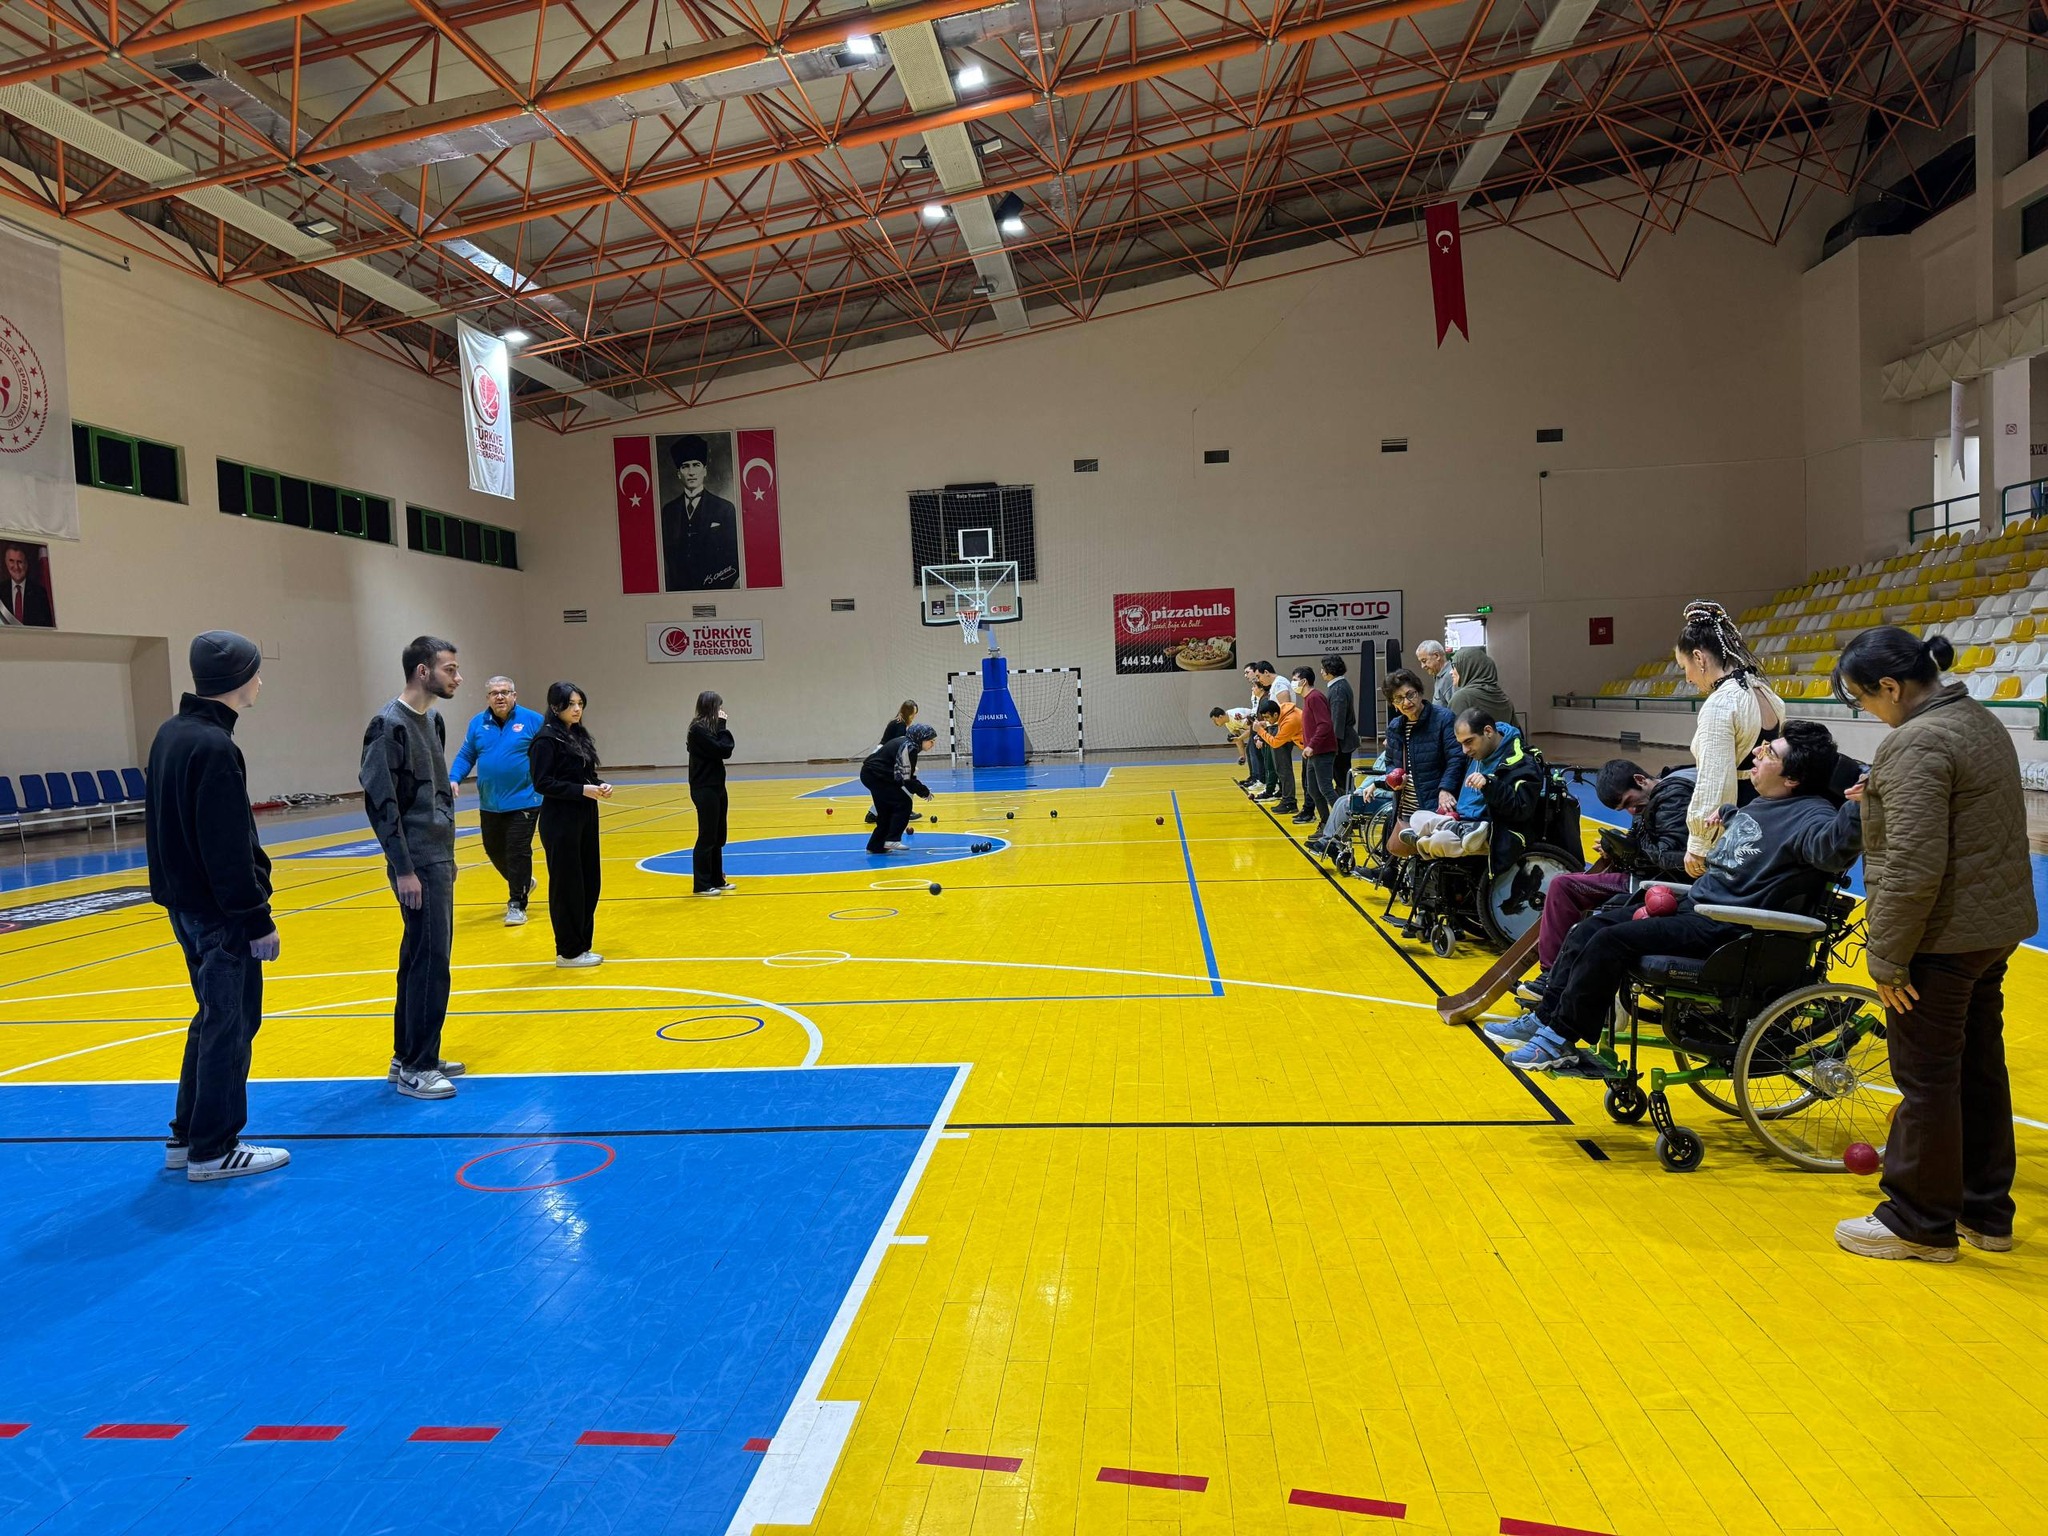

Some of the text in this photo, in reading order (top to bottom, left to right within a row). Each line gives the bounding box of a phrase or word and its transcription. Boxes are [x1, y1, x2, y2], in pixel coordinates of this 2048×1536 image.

[12, 354, 20, 366] VE
[18, 368, 28, 392] SPOR
[474, 425, 503, 446] TÜRKİYE
[1151, 603, 1231, 622] pizzabulls
[693, 625, 752, 639] TÜRKİYE
[1320, 631, 1345, 639] TEŞKİLAT
[1346, 628, 1389, 637] BAŞKANLIĞINCA
[693, 639, 753, 649] BASKETBOL
[693, 647, 753, 656] FEDERASYONU
[1121, 655, 1164, 667] 444 32 44
